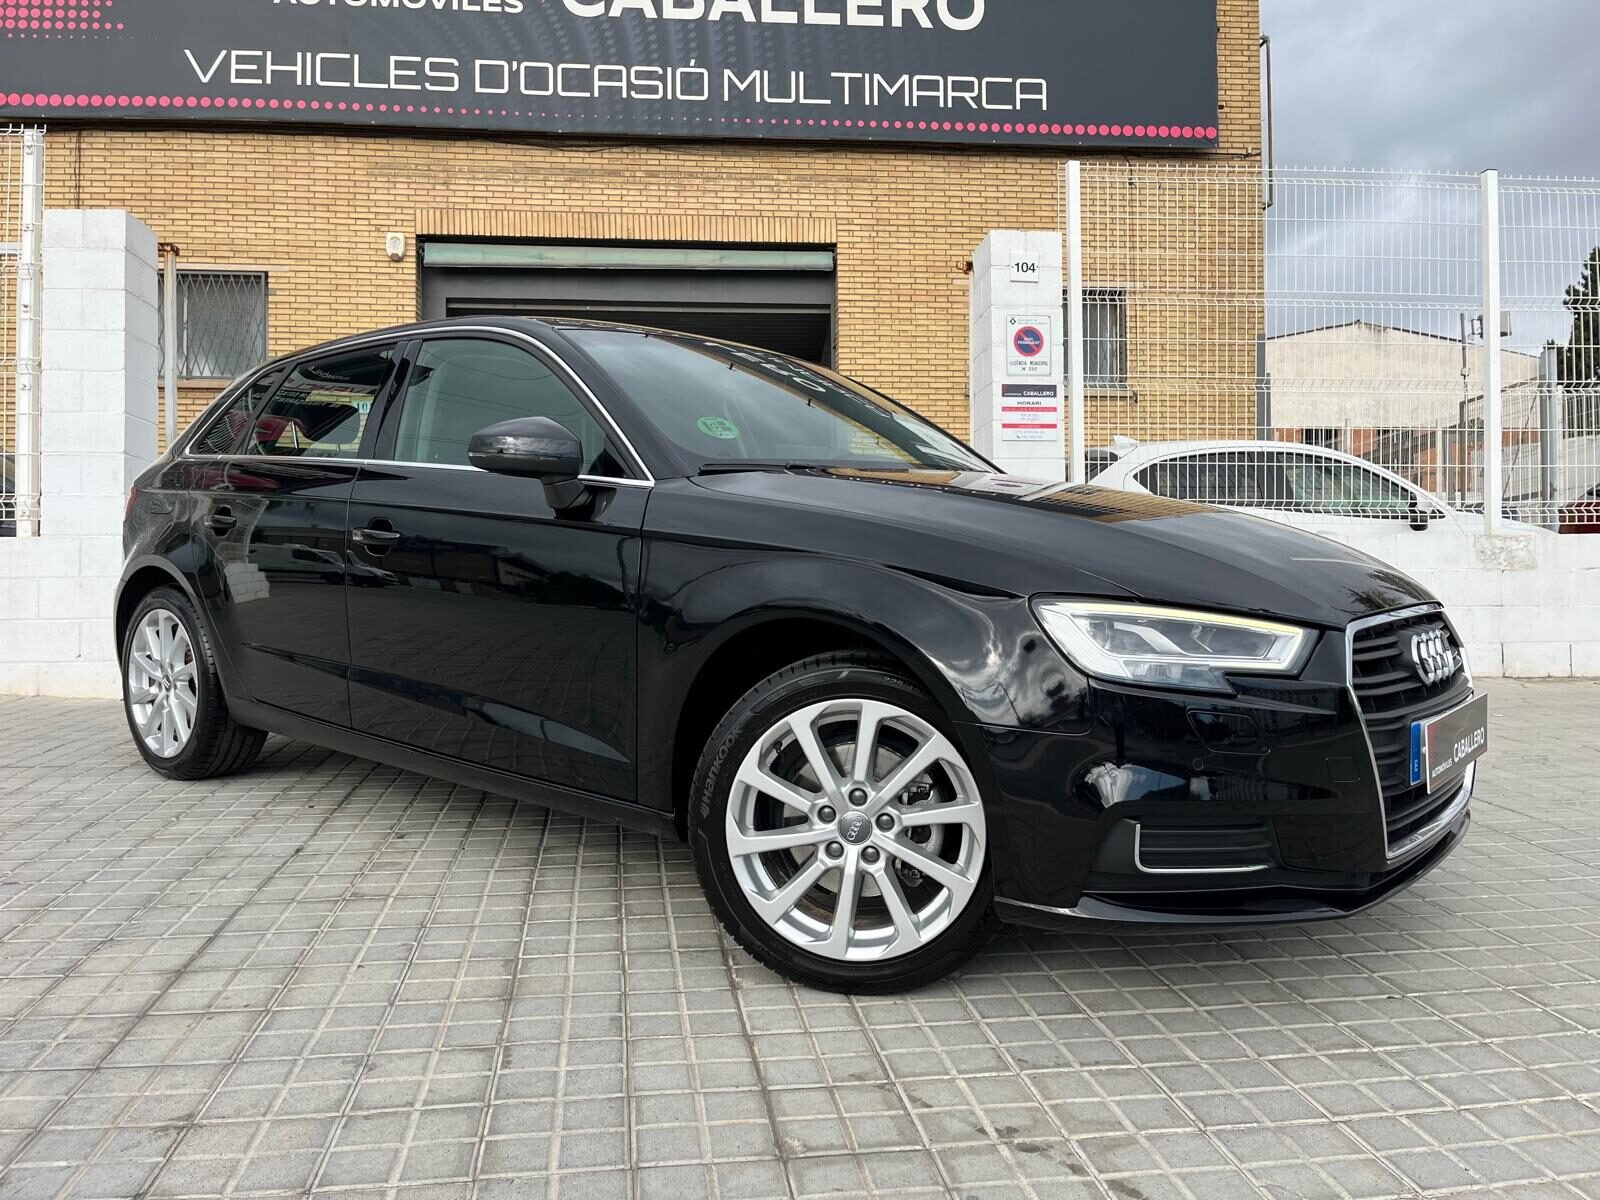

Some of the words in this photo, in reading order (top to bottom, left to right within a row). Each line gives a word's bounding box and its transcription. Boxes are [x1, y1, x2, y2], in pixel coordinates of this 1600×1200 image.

[184, 48, 459, 92] VEHICLES
[722, 68, 1048, 111] MULTIMARCA
[1014, 261, 1036, 273] 104
[1454, 727, 1485, 762] CABALLERO
